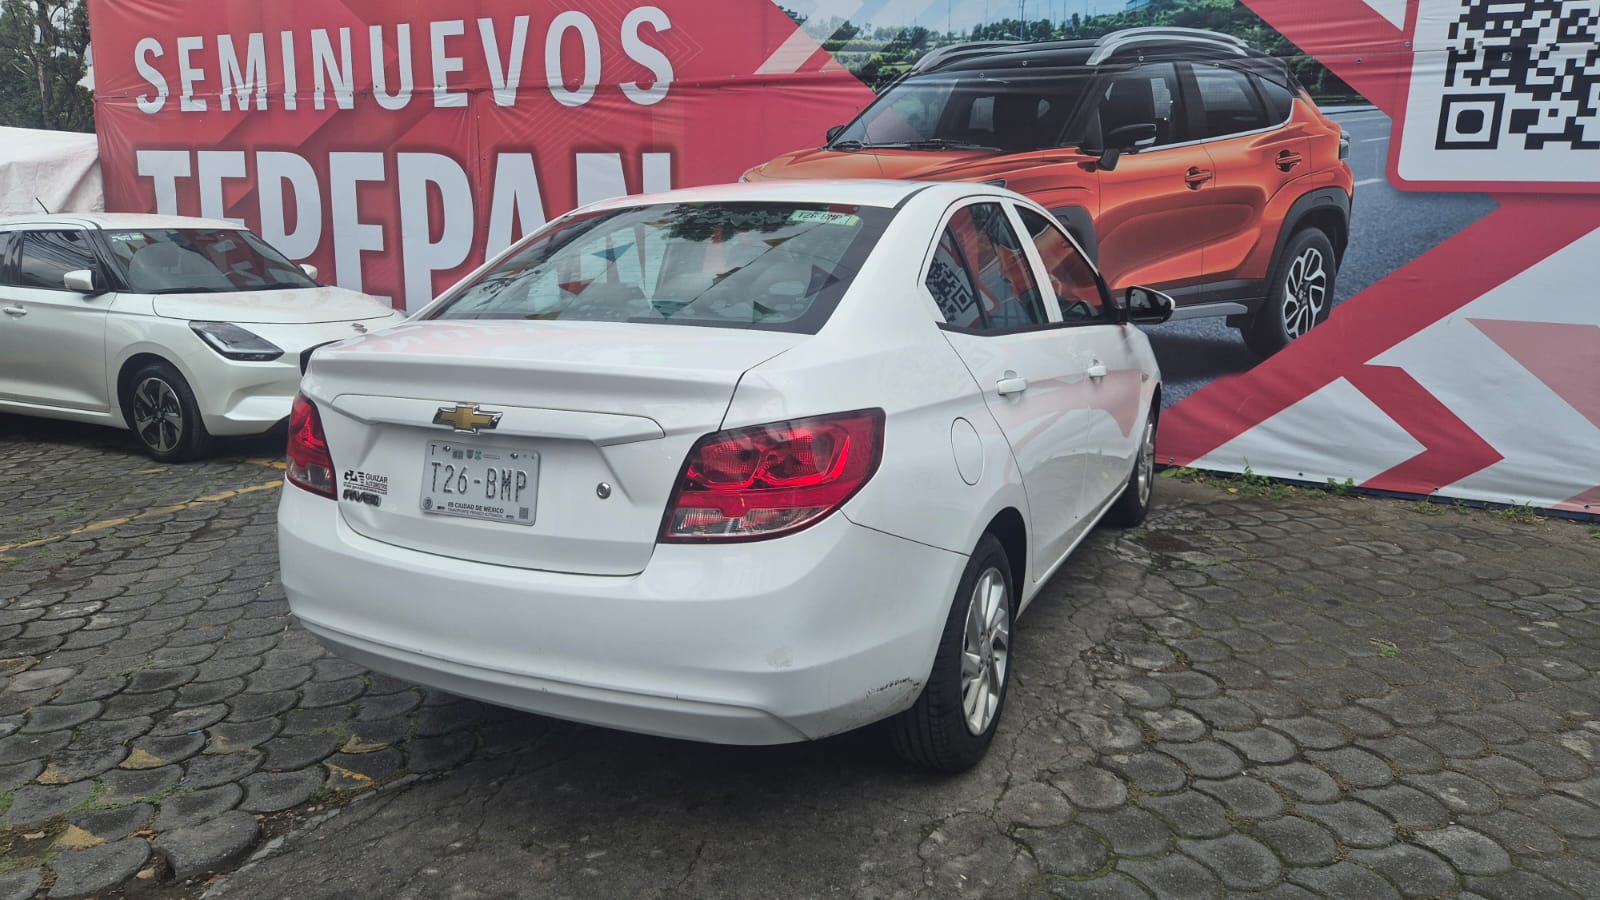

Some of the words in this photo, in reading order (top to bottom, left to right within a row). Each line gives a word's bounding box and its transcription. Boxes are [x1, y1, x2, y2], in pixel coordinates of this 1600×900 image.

[134, 6, 674, 113] SEMINUEVOS
[431, 444, 437, 456] T
[430, 461, 528, 503] T26-BMP
[454, 502, 475, 510] CIUDAD
